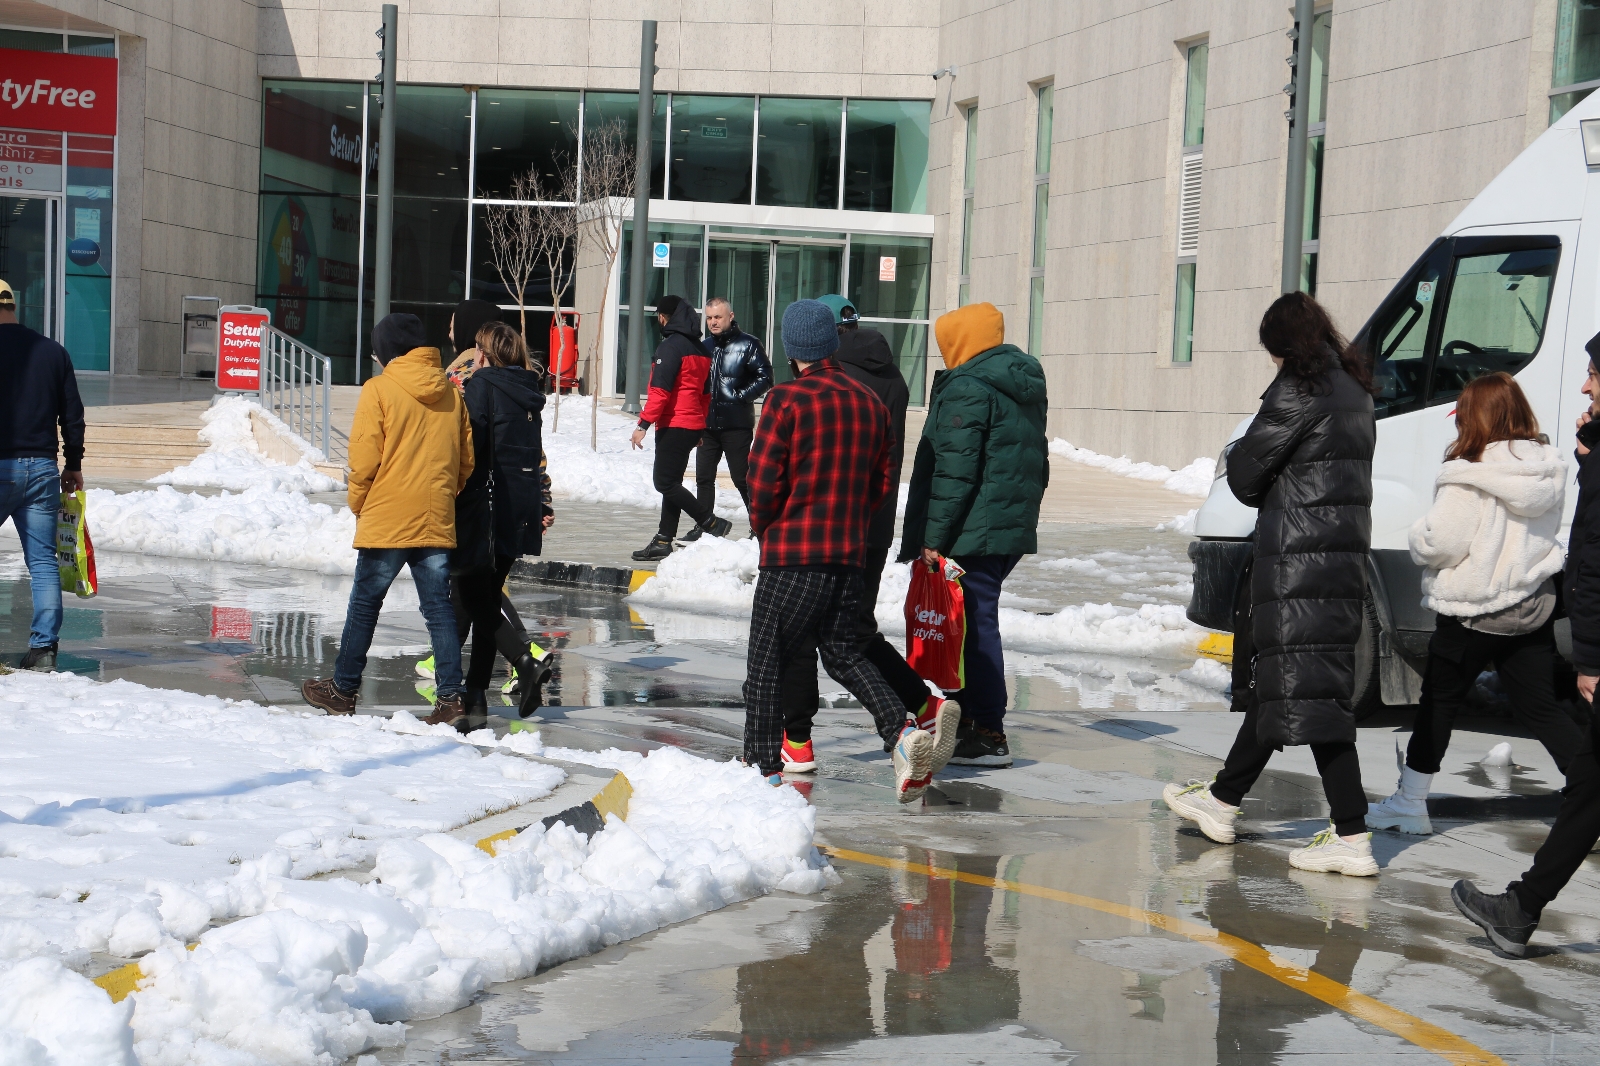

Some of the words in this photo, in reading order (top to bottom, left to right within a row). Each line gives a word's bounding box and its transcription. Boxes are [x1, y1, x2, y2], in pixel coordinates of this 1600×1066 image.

[0, 79, 96, 109] tyFree
[17, 164, 34, 175] to
[285, 311, 300, 331] offer
[244, 357, 261, 365] Entry
